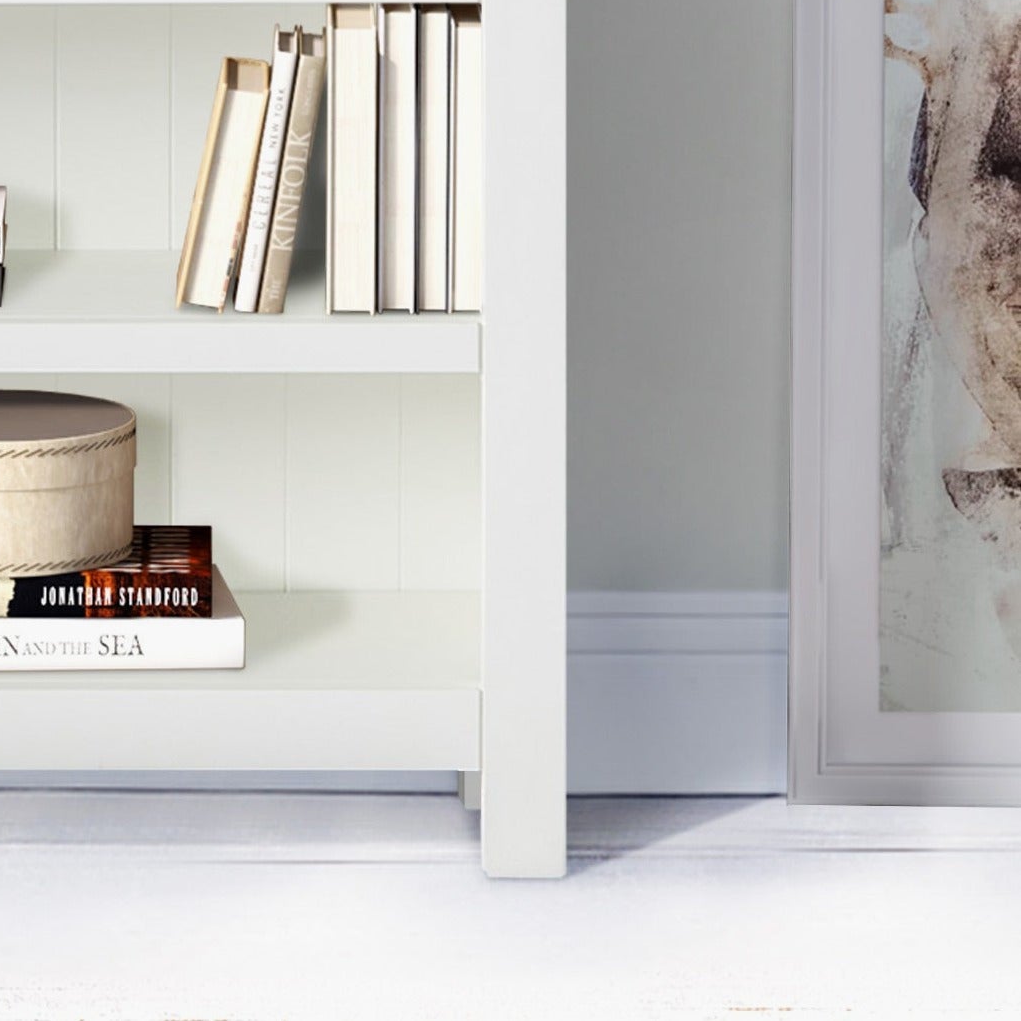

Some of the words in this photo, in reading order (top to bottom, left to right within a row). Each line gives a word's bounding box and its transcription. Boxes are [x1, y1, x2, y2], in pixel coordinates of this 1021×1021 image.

[274, 89, 285, 117] YORK
[269, 123, 280, 148] NEW
[272, 130, 312, 252] KINFOLK
[40, 585, 113, 607] JONATHAN
[118, 586, 199, 607] STANDFORD
[22, 641, 56, 656] AND
[59, 641, 92, 656] THE
[97, 634, 145, 657] SEA
